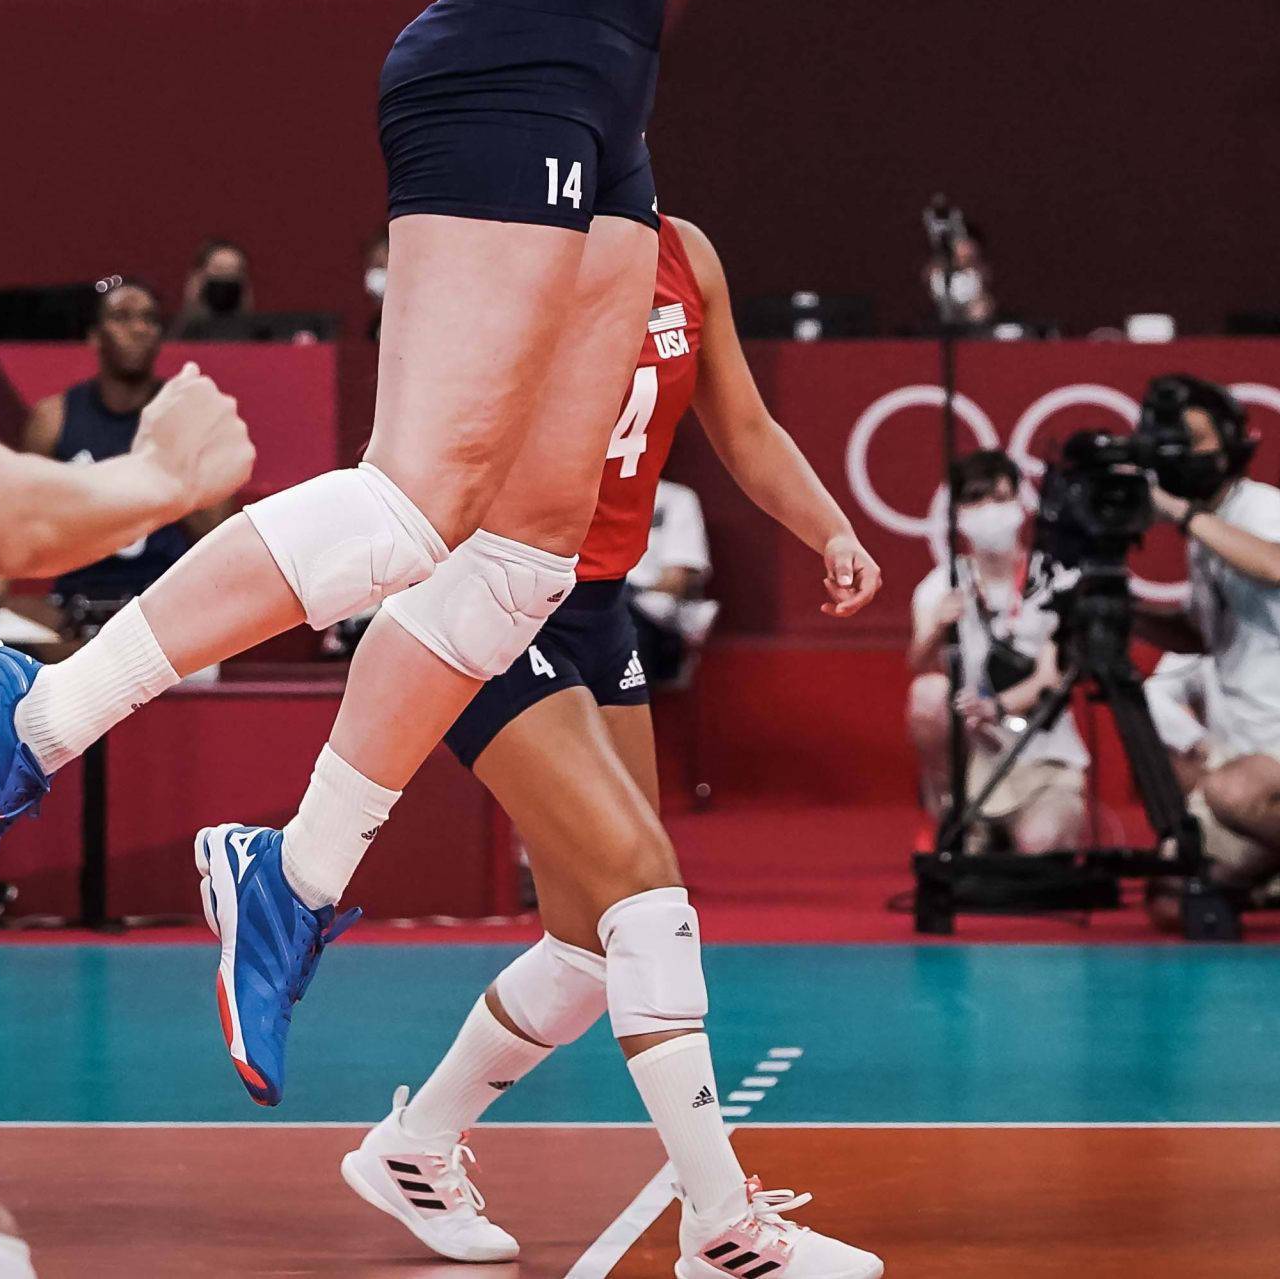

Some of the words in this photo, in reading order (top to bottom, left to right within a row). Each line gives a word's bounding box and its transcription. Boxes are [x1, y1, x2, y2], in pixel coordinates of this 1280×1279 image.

[545, 157, 583, 209] 14
[653, 328, 690, 360] USA
[605, 365, 659, 480] 4
[528, 644, 557, 680] 4
